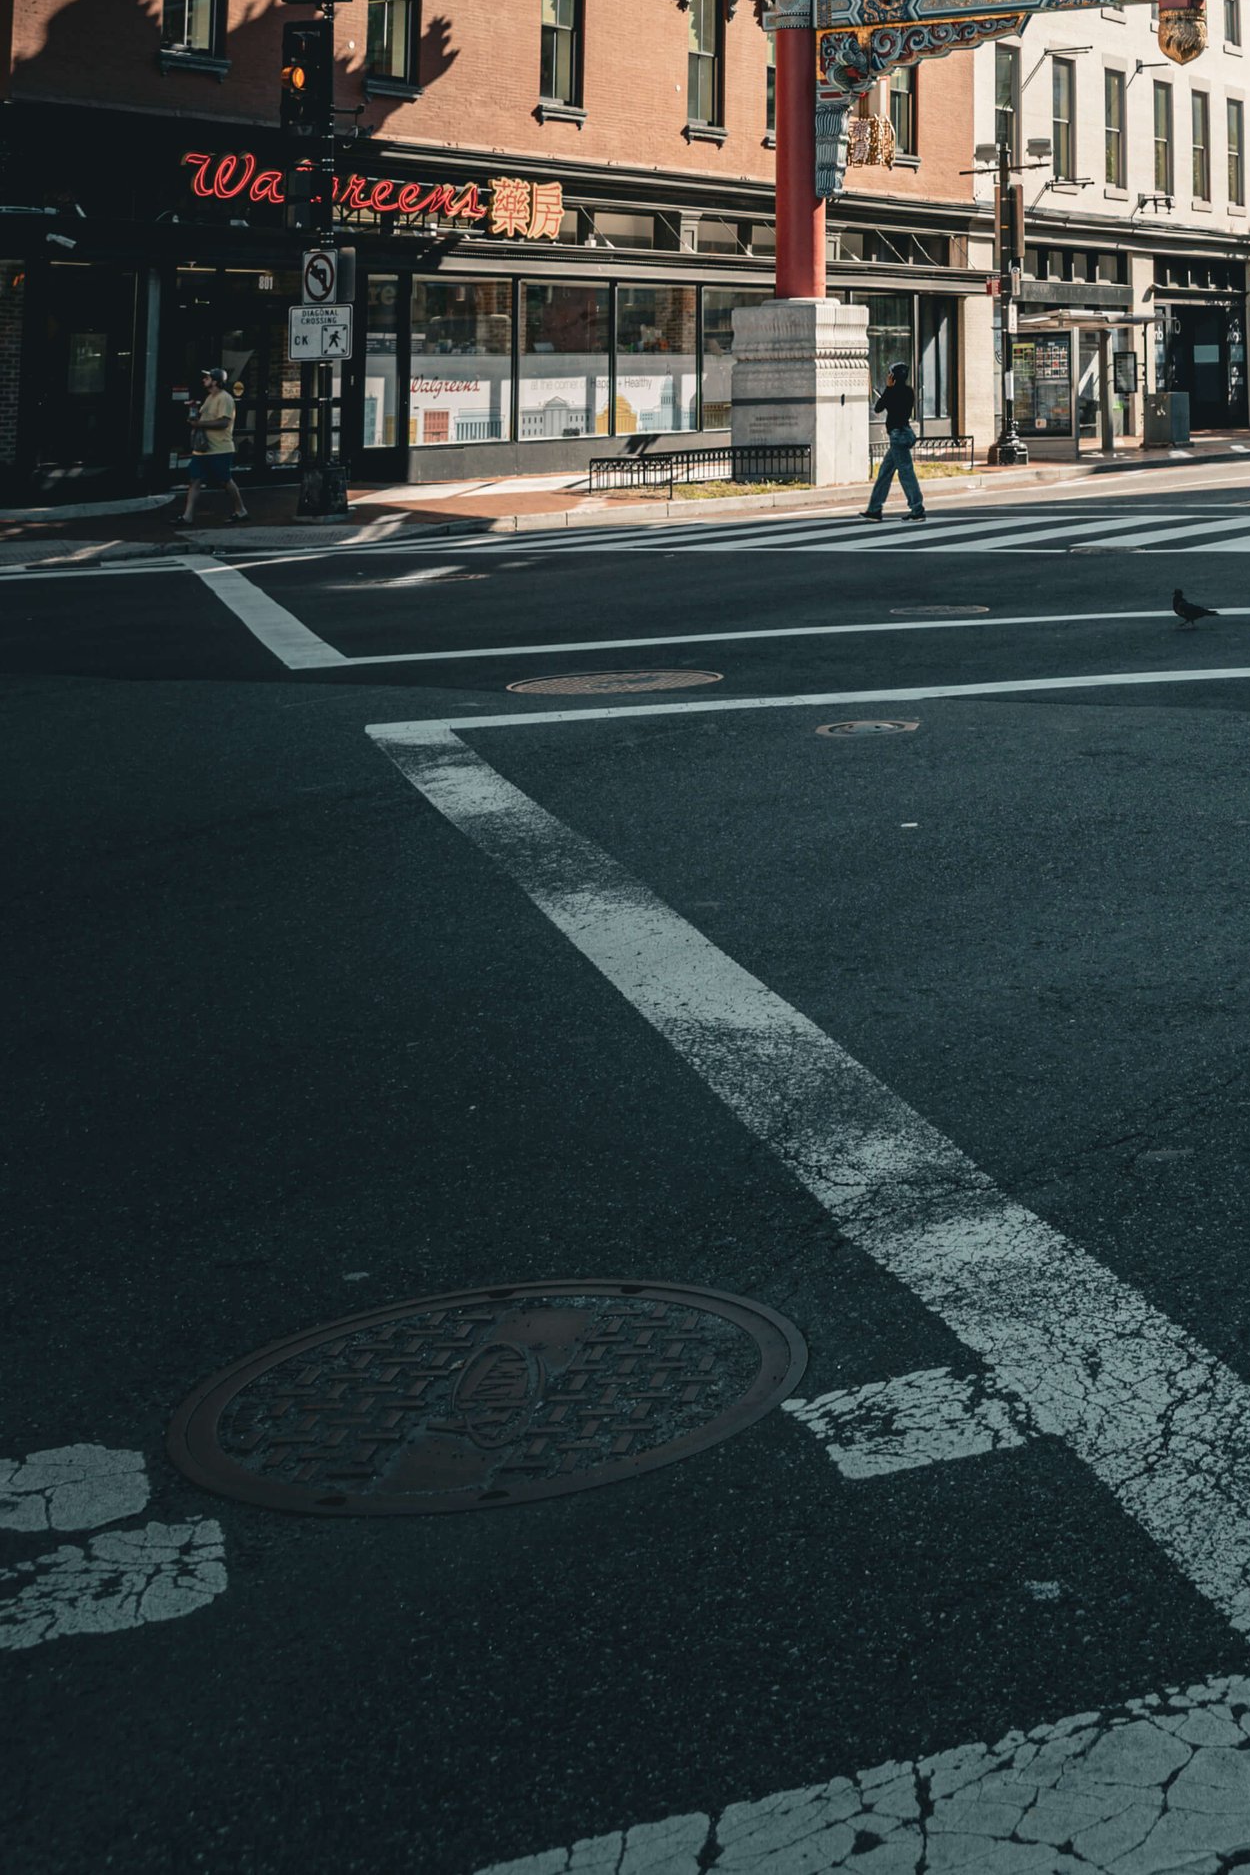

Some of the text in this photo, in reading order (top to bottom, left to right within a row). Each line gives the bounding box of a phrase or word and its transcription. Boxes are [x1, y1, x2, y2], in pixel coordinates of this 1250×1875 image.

[180, 152, 487, 219] Wareens
[489, 175, 565, 238] 藥房
[258, 276, 273, 290] 801
[301, 309, 339, 317] DIAGONAL
[300, 317, 337, 325] CROSSING
